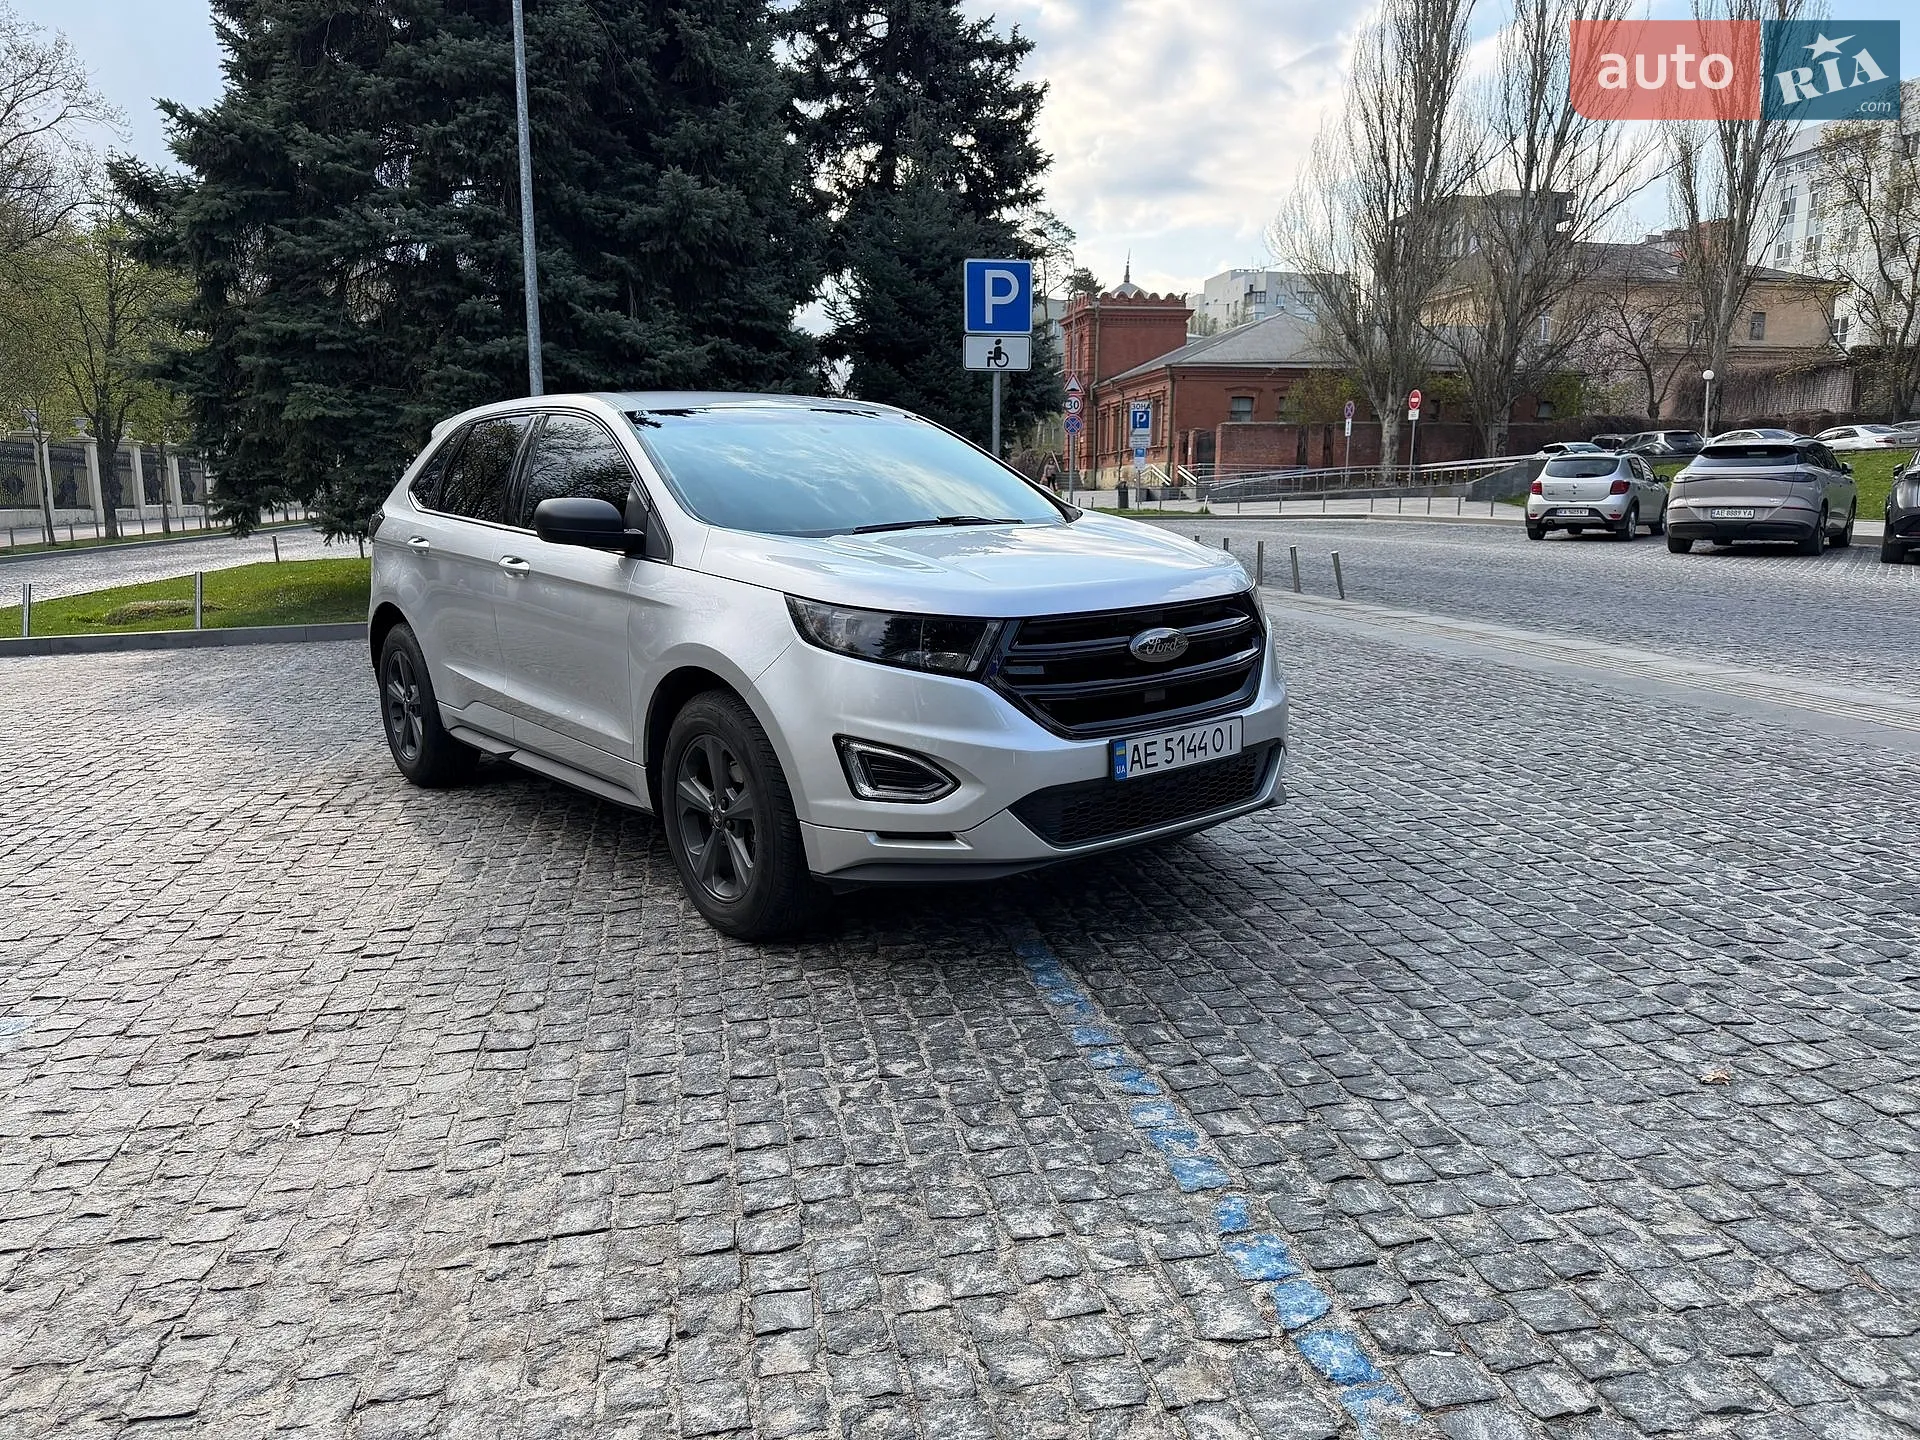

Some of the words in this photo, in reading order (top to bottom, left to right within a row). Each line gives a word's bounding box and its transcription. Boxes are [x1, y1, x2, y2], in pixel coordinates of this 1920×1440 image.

[984, 269, 1020, 324] P
[1065, 400, 1080, 410] 30
[1136, 412, 1147, 428] P
[1146, 636, 1179, 655] Ford
[1129, 740, 1159, 772] AE
[1164, 730, 1208, 765] 5144
[1116, 765, 1126, 775] UA
